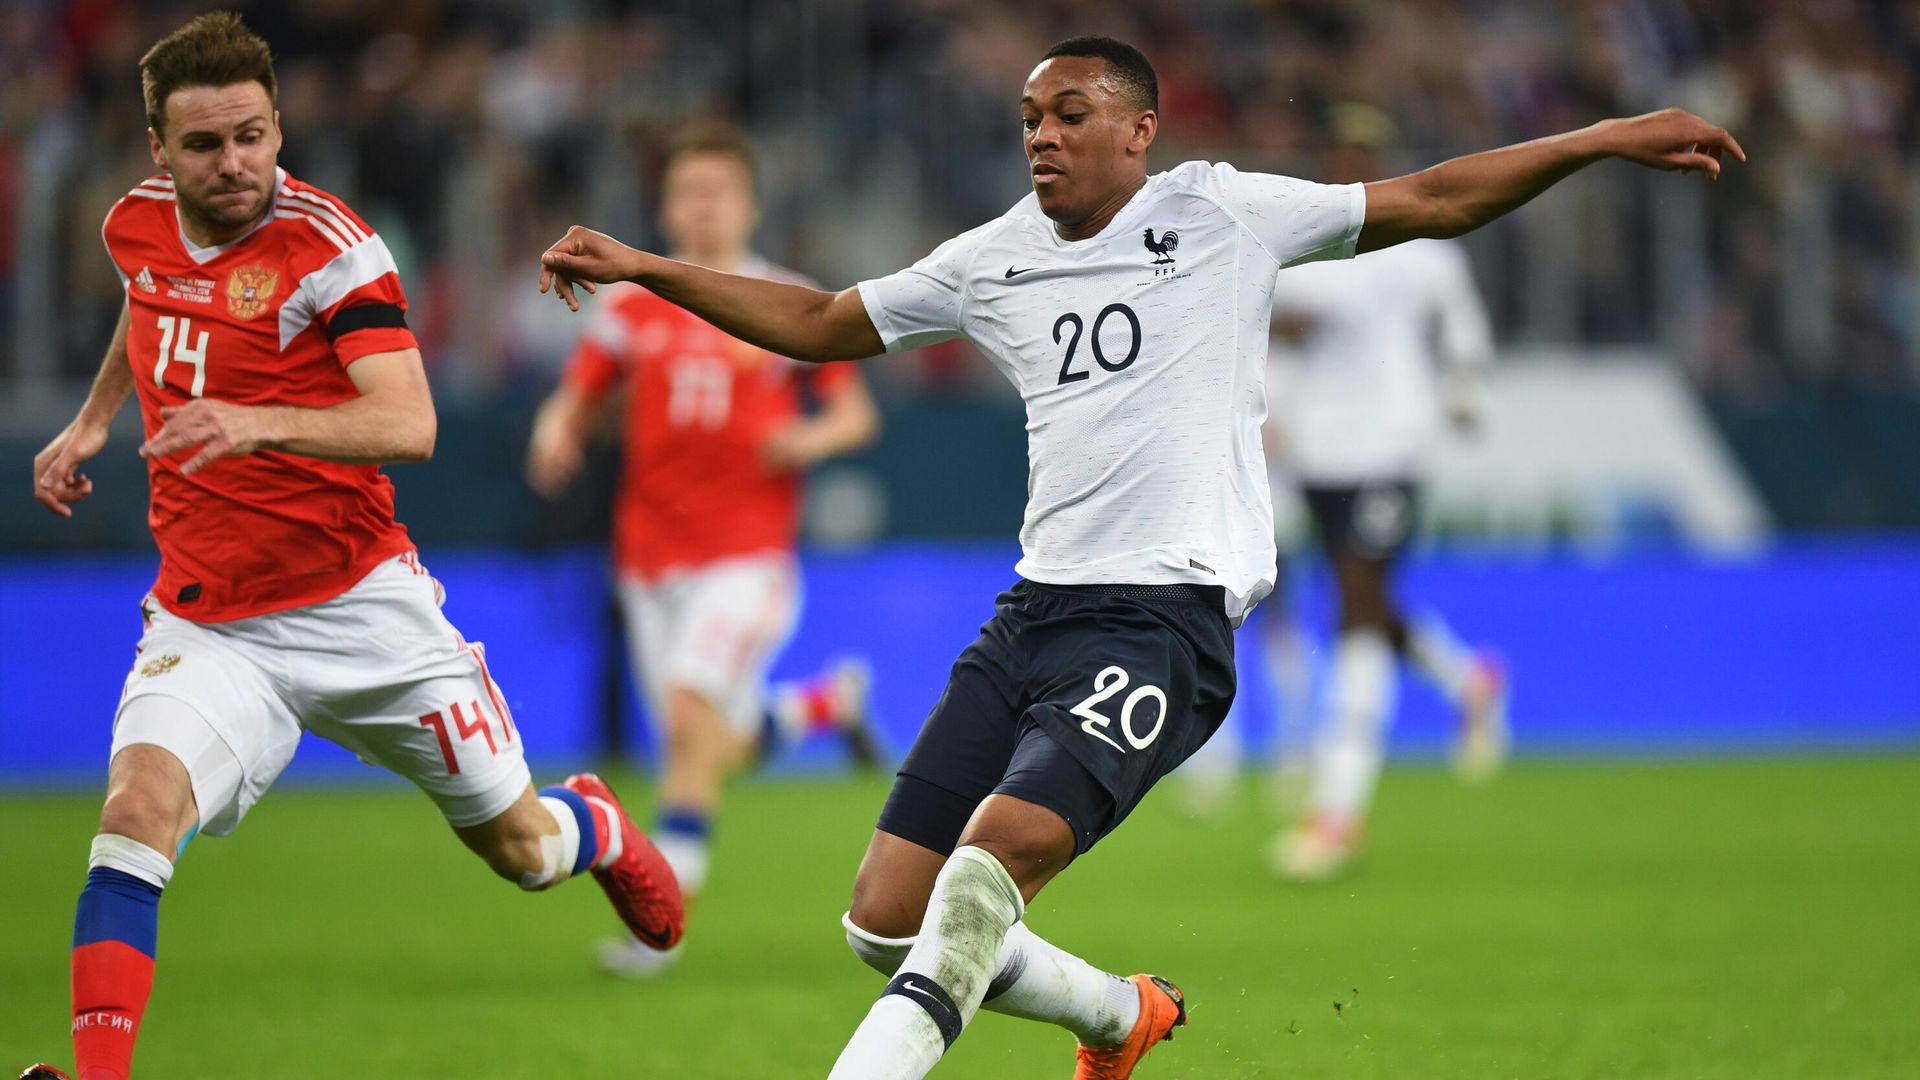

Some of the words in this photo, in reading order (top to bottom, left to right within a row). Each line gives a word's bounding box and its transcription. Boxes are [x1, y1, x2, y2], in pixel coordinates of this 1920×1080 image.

[154, 315, 210, 398] 14
[1052, 303, 1142, 386] 20
[418, 699, 499, 776] 14
[1069, 665, 1168, 750] 20
